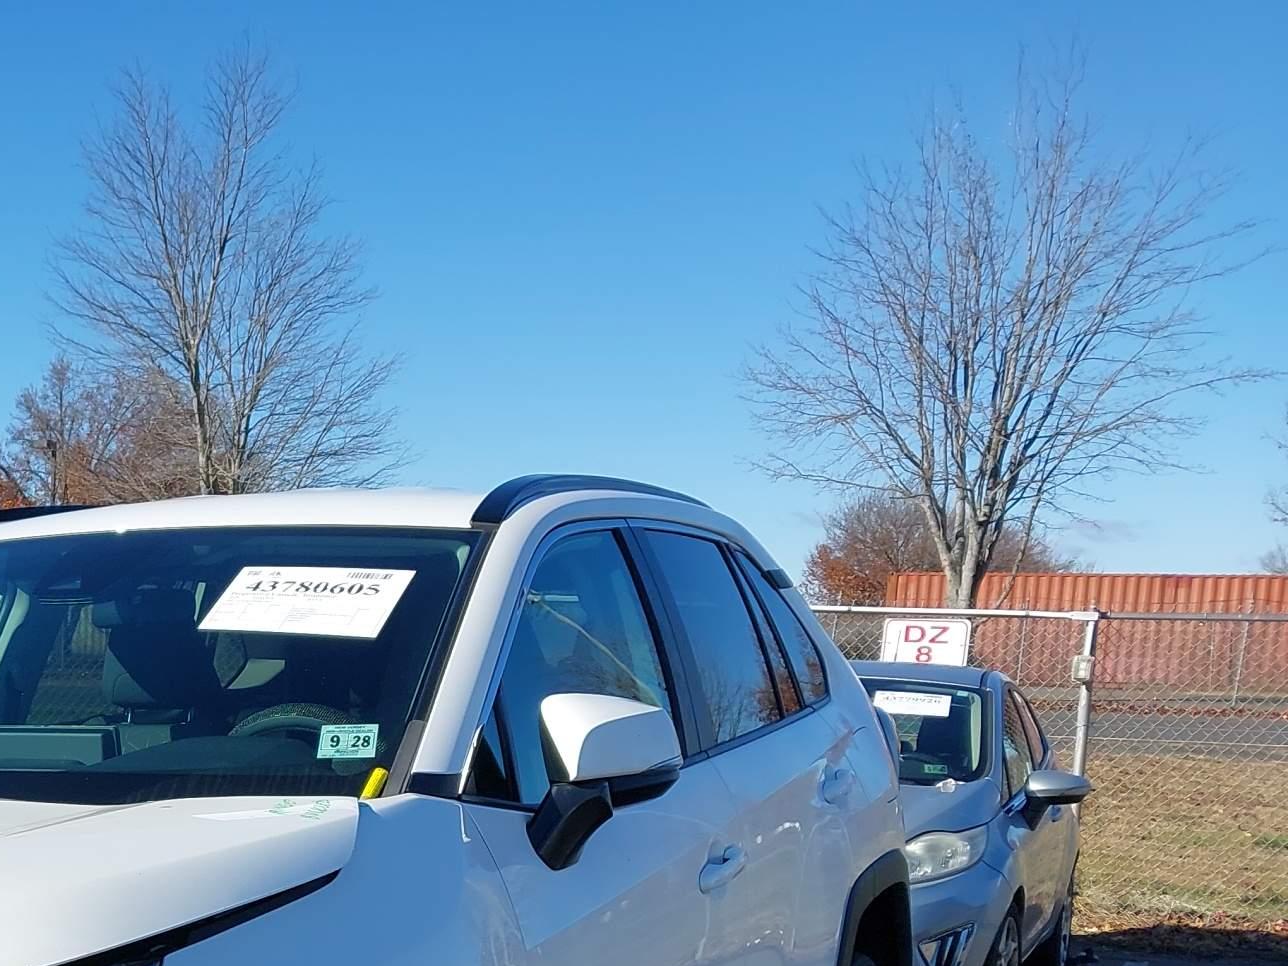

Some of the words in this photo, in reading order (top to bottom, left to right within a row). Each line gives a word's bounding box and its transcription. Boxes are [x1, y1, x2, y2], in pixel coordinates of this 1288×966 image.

[245, 580, 381, 597] 43780605
[903, 625, 950, 644] DZ
[915, 645, 933, 664] 8
[329, 734, 341, 748] 9
[350, 734, 372, 748] 28
